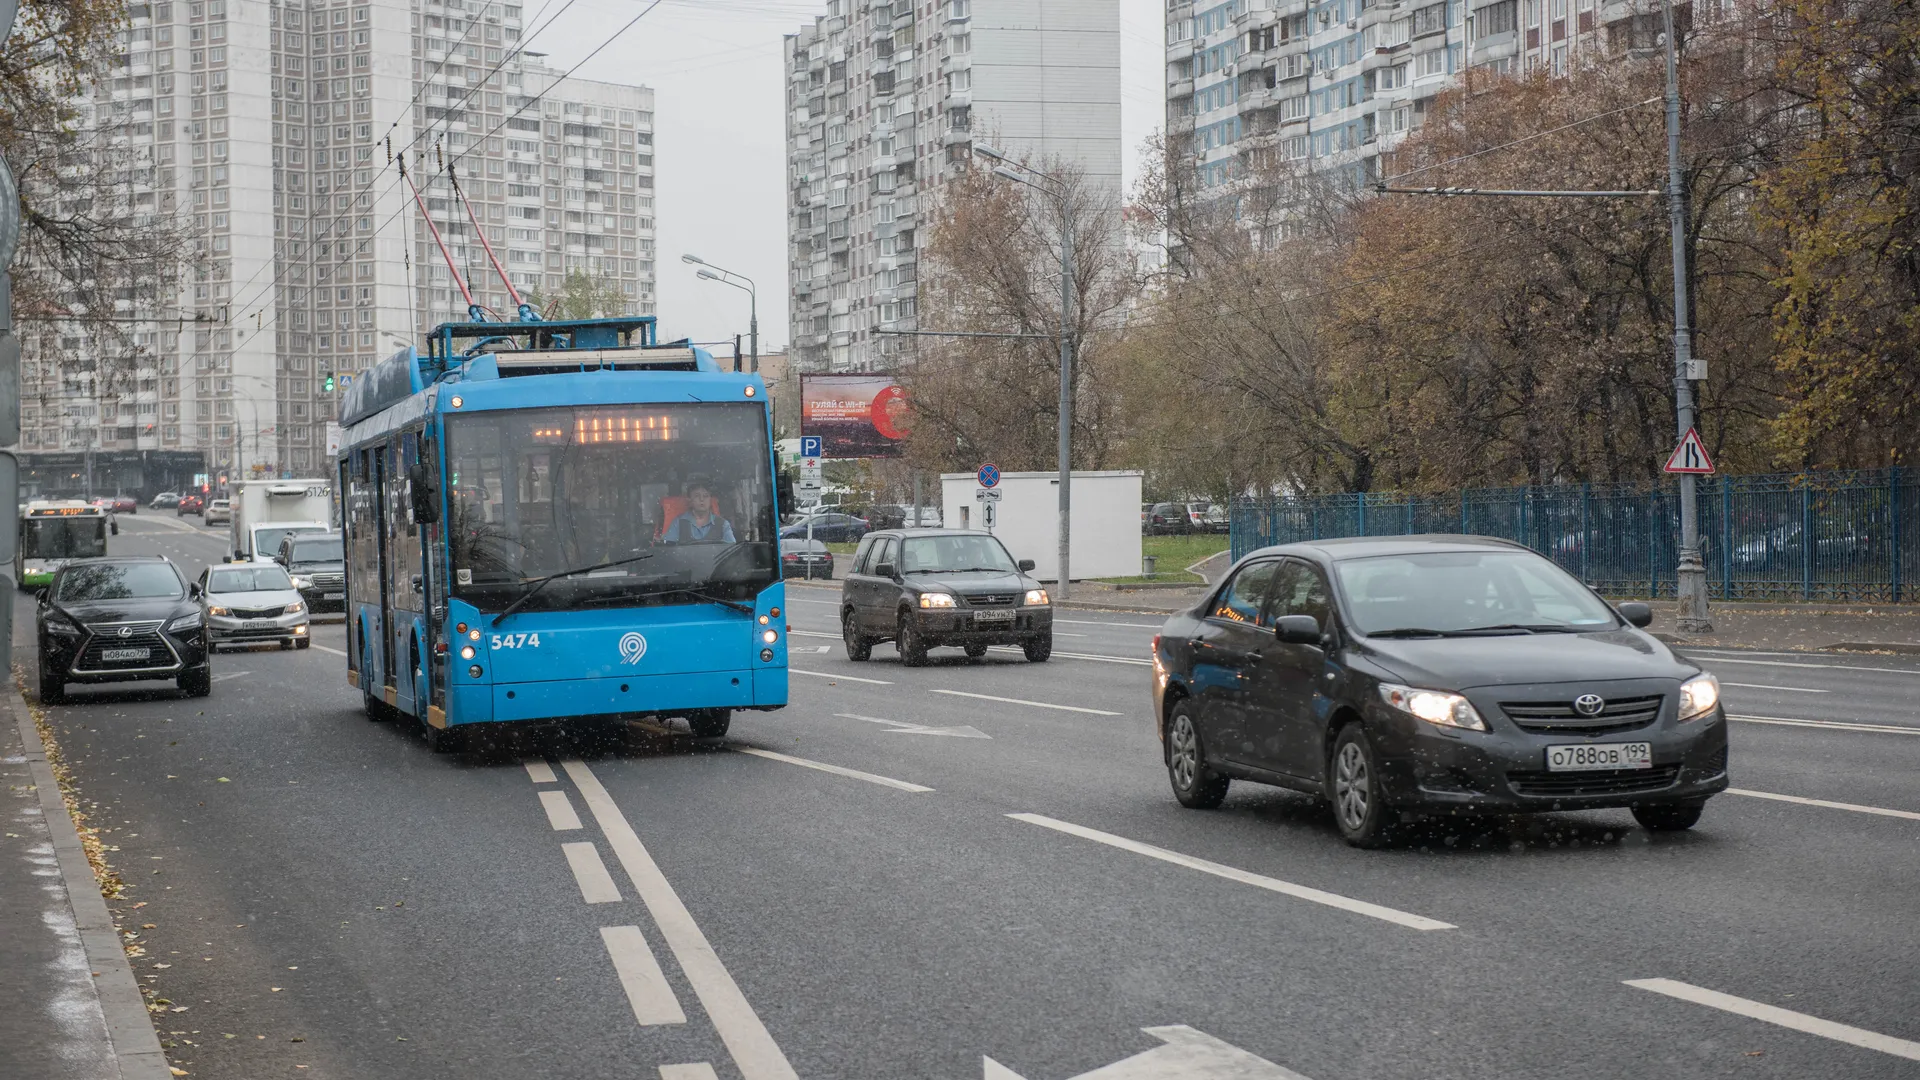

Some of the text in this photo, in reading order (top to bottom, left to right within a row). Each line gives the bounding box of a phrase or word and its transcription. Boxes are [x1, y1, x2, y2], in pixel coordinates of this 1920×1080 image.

[811, 399, 837, 408] ГУЛЯЙ
[805, 439, 817, 455] P
[491, 633, 540, 650] 5474
[1553, 744, 1647, 765] О788ОВ 199
